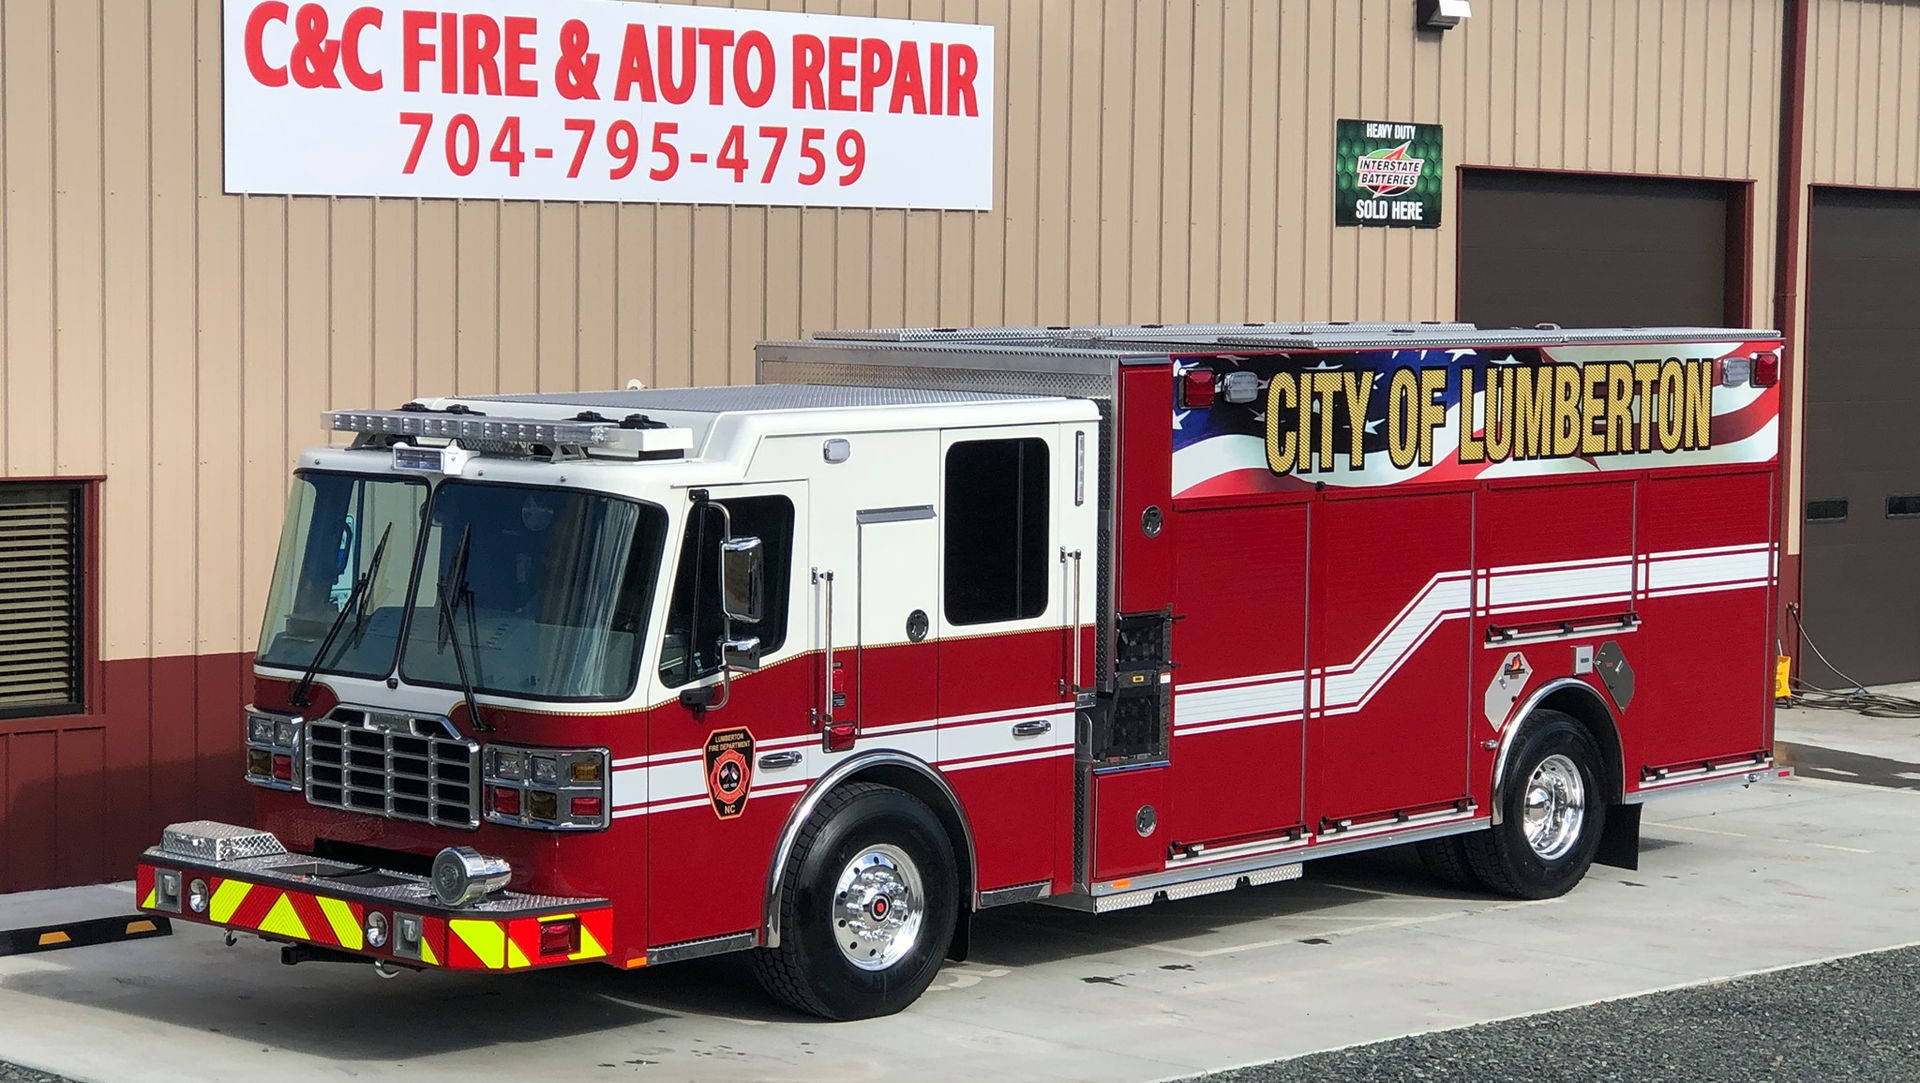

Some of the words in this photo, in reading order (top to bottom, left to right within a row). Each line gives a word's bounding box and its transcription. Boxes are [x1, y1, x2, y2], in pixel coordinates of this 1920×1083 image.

[244, 0, 385, 92] C&C
[402, 9, 539, 98] FIRE
[554, 18, 601, 101] &
[614, 23, 777, 109] AUTO
[792, 33, 979, 118] REPAIR
[1366, 123, 1393, 139] HEAVY
[1394, 125, 1416, 140] DUTY
[399, 111, 867, 187] 704-795-4759
[1359, 160, 1420, 172] INTERSTATE
[1361, 173, 1416, 186] BATTERIES
[1355, 199, 1388, 219] SOLD
[1391, 200, 1423, 220] HERE
[1265, 368, 1374, 476] CITY
[1388, 365, 1449, 468] OF
[1458, 358, 1713, 465] LUMBERTON
[714, 733, 744, 743] LUMBERTON
[708, 744, 719, 752] FIRE
[719, 740, 751, 751] DEPARTMENT
[724, 804, 736, 814] NC
